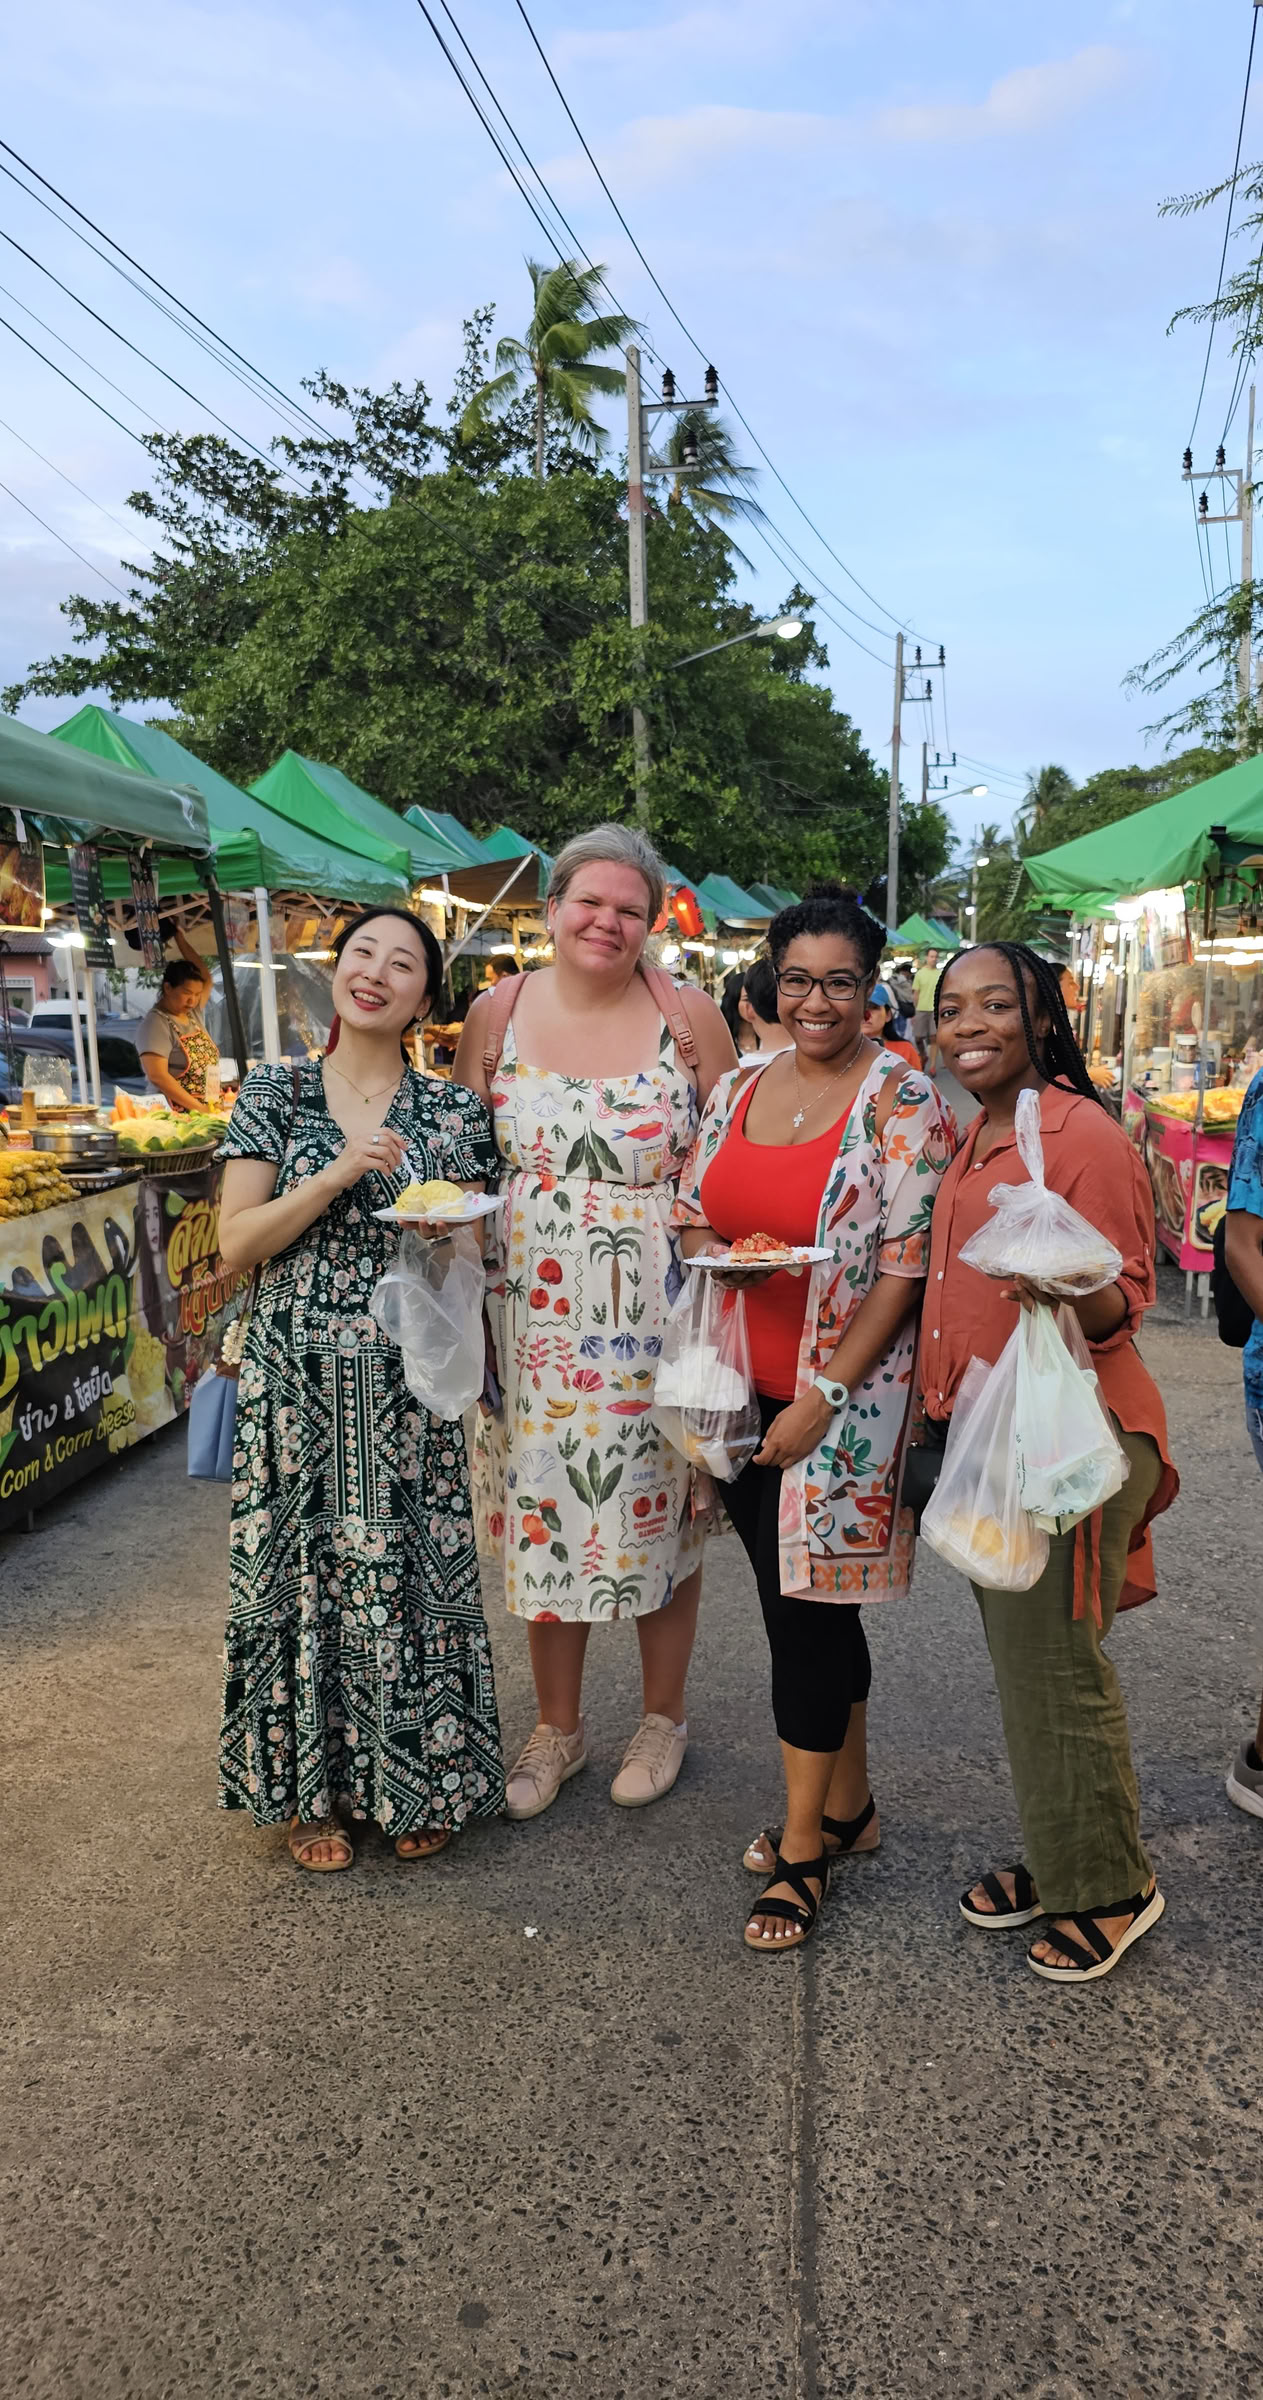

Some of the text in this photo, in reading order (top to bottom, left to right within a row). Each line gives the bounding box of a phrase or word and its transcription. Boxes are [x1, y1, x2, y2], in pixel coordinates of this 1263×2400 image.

[64, 1394, 75, 1420] &
[0, 1400, 135, 1498] Corn & Corn cheese
[632, 1470, 656, 1482] CAPRI
